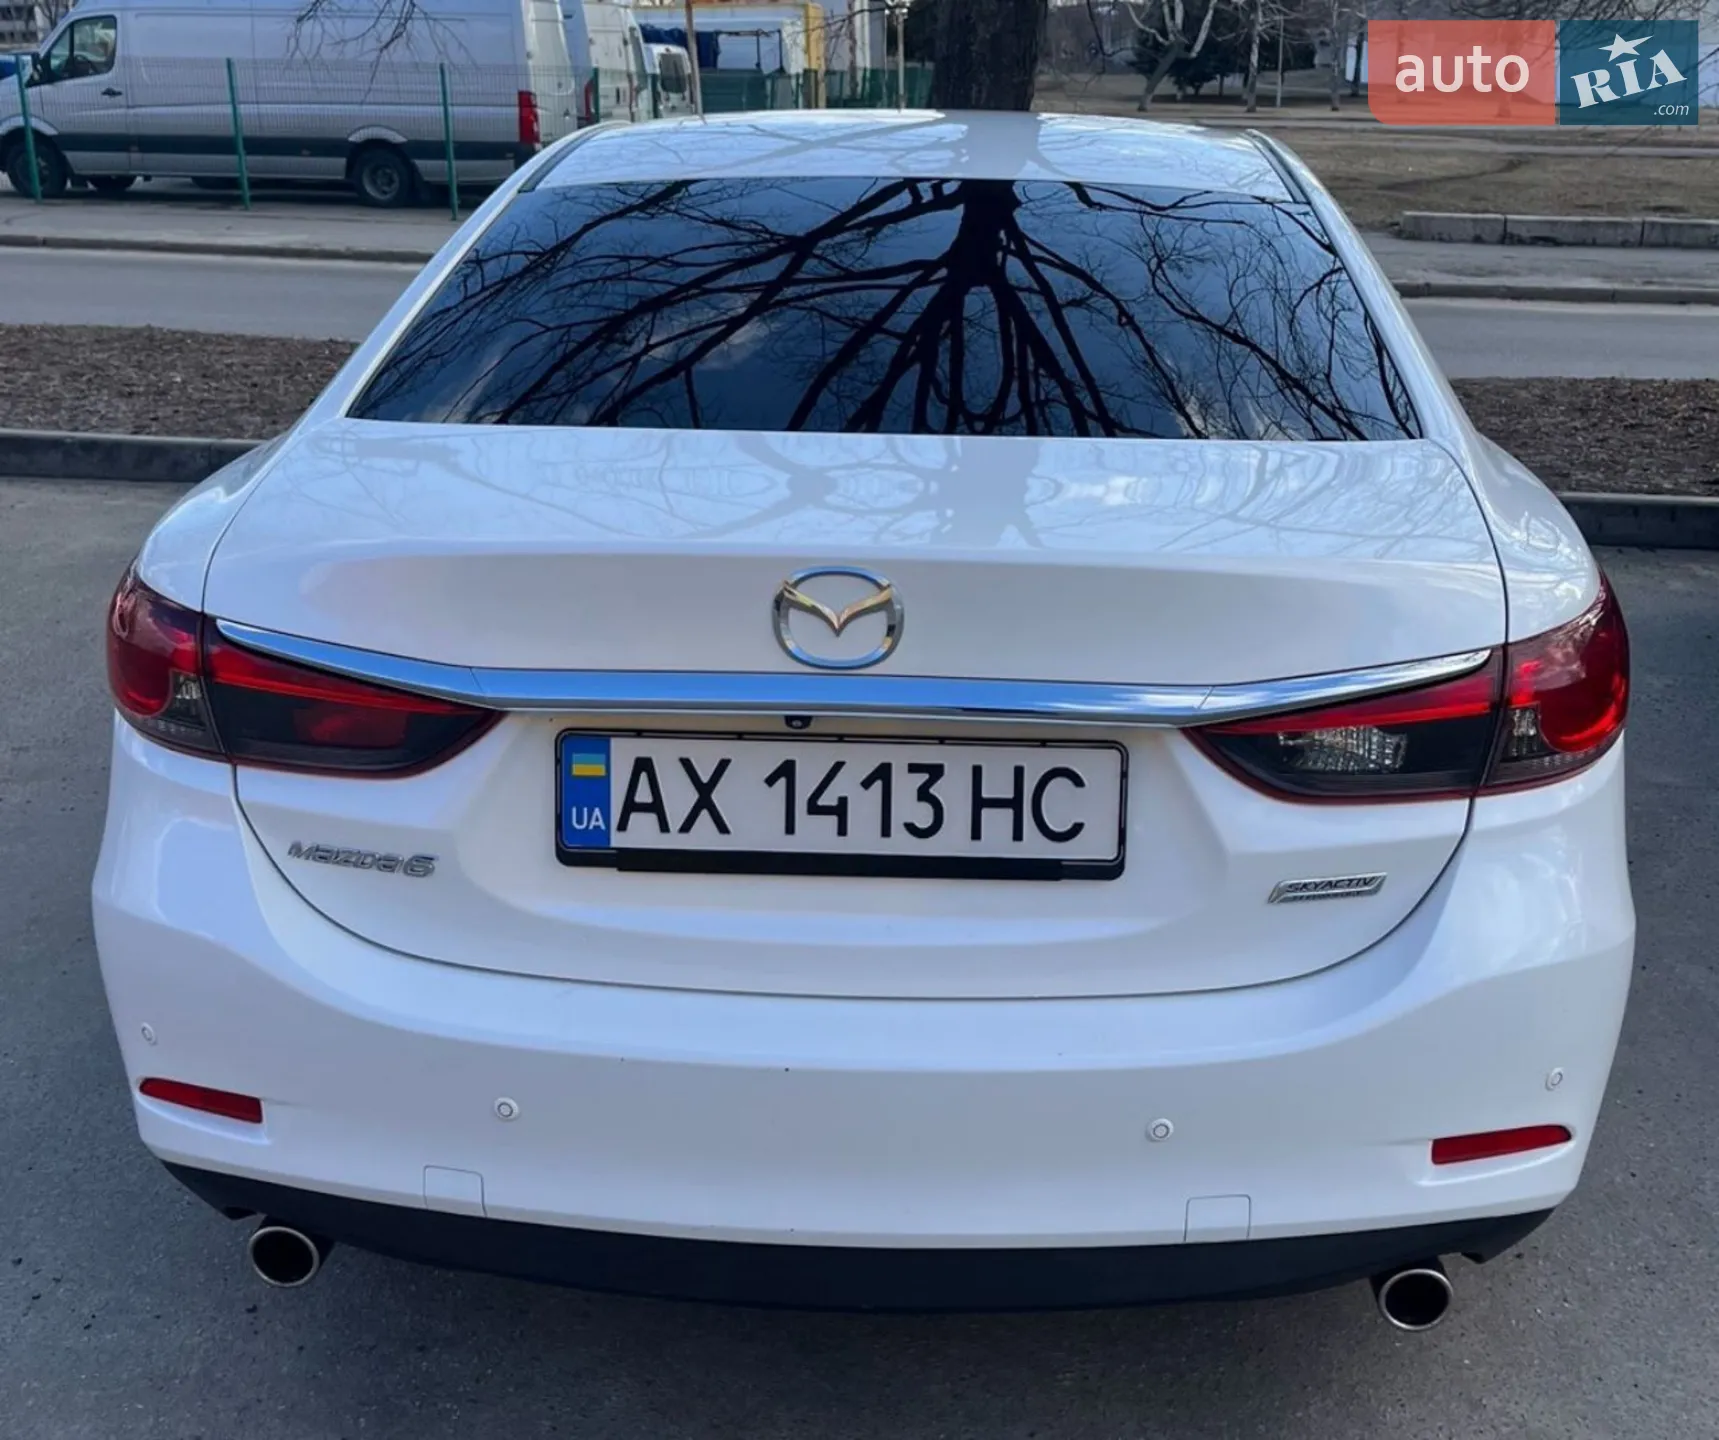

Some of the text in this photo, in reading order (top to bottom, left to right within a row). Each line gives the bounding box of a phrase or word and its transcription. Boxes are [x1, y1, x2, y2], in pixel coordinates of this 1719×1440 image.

[616, 756, 1086, 843] AX 1413 HC
[571, 806, 606, 830] UA
[1285, 876, 1377, 893] SKYACTIV
